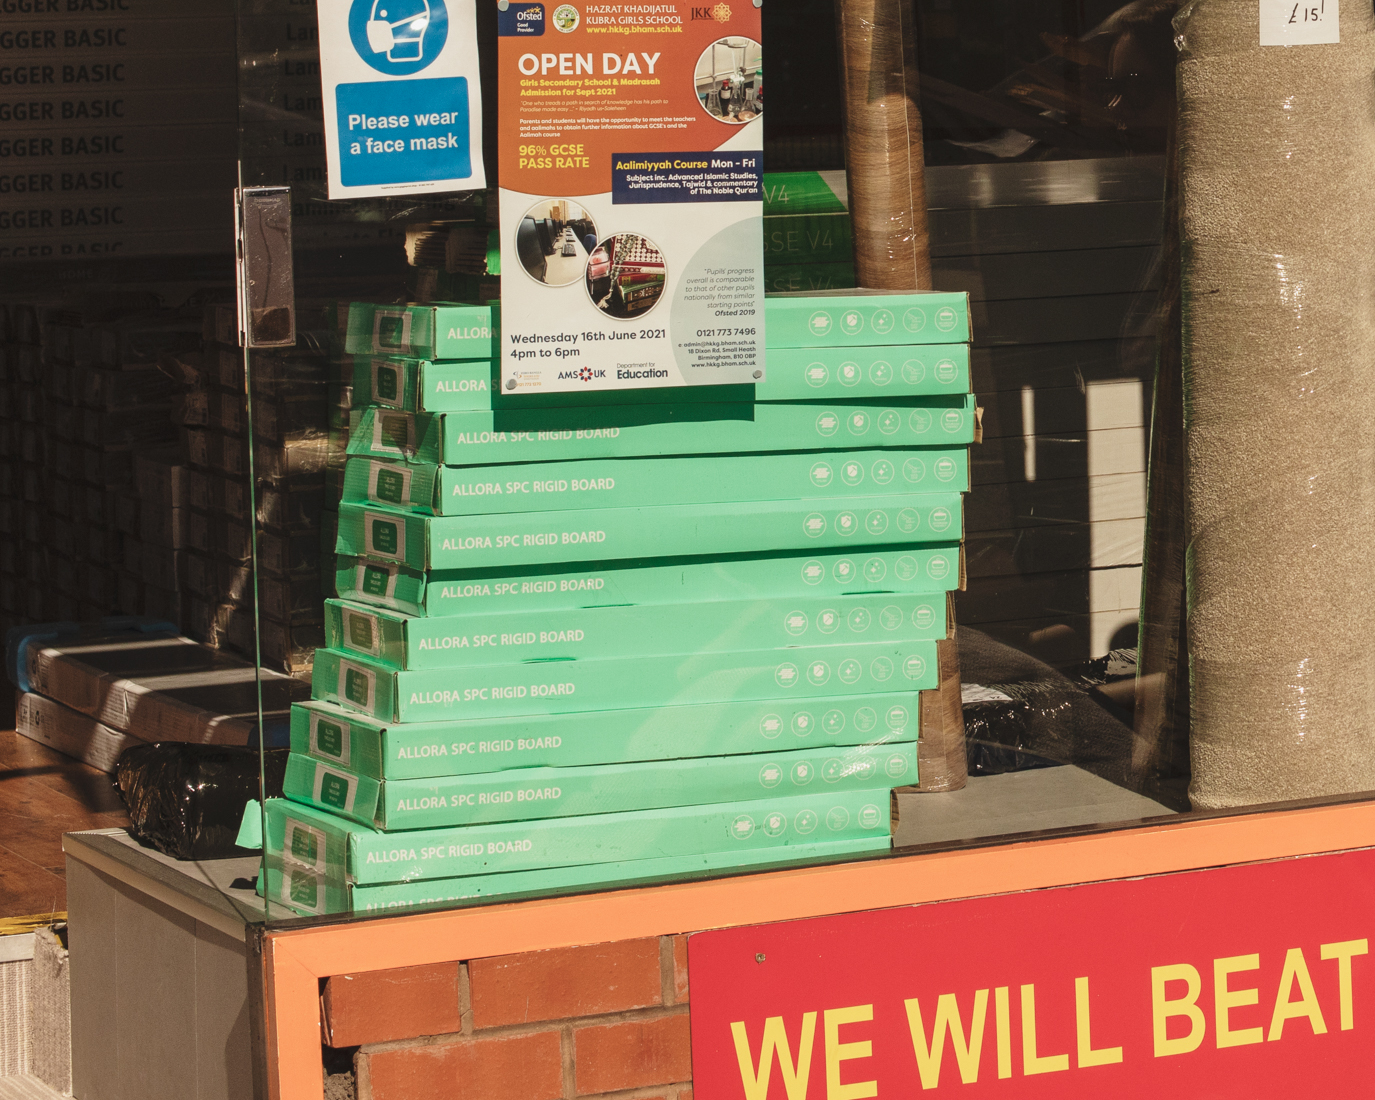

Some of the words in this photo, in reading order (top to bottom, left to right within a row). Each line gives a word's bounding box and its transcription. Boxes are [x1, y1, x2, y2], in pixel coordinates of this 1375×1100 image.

[586, 5, 622, 14] HAZRAT
[624, 5, 677, 13] KHADIJATUL
[517, 11, 542, 21] Ofsted
[586, 16, 616, 25] KUBRA
[619, 16, 644, 24] GIRLS
[646, 16, 683, 24] SCHOOL
[586, 25, 683, 35] www.hkkg.bham.sch.uk
[518, 52, 593, 75] OPEN
[603, 53, 661, 75] DAY
[520, 79, 538, 87] Girls
[540, 79, 582, 88] Secondary
[620, 78, 660, 86] Madrasah
[520, 88, 561, 97] Admission
[563, 88, 574, 96] for
[576, 88, 595, 97] Sept
[349, 114, 409, 130] Please
[415, 112, 458, 126] wear
[350, 142, 361, 155] a
[366, 137, 405, 153] face
[410, 132, 458, 150] mask
[519, 145, 546, 156] 96%
[550, 144, 584, 155] GCSE
[519, 158, 552, 169] PASS
[556, 157, 590, 168] RATE
[616, 161, 672, 172] Aalimiyyah
[674, 160, 707, 169] Course
[711, 159, 733, 169] Mon
[743, 159, 755, 168] Fri
[511, 332, 578, 345] Wednesday
[581, 332, 605, 341] 16th
[608, 330, 636, 341] June
[640, 329, 666, 339] 2021
[696, 329, 714, 337] 0121
[734, 328, 756, 336] 7496
[511, 349, 537, 360] 4pm
[540, 349, 551, 358] to
[555, 348, 580, 358] 6pm
[617, 368, 668, 379] Education
[453, 483, 502, 496] ALLORA
[506, 482, 529, 493] SPC
[533, 480, 568, 493] RIGID
[571, 478, 615, 491] BOARD
[367, 850, 417, 864] ALLORA
[421, 848, 445, 859] SPC
[449, 844, 484, 857] RIGID
[487, 840, 532, 854] BOARD
[730, 1004, 878, 1100] WE
[904, 977, 1123, 1090] WILL
[1151, 940, 1368, 1058] BEAT
